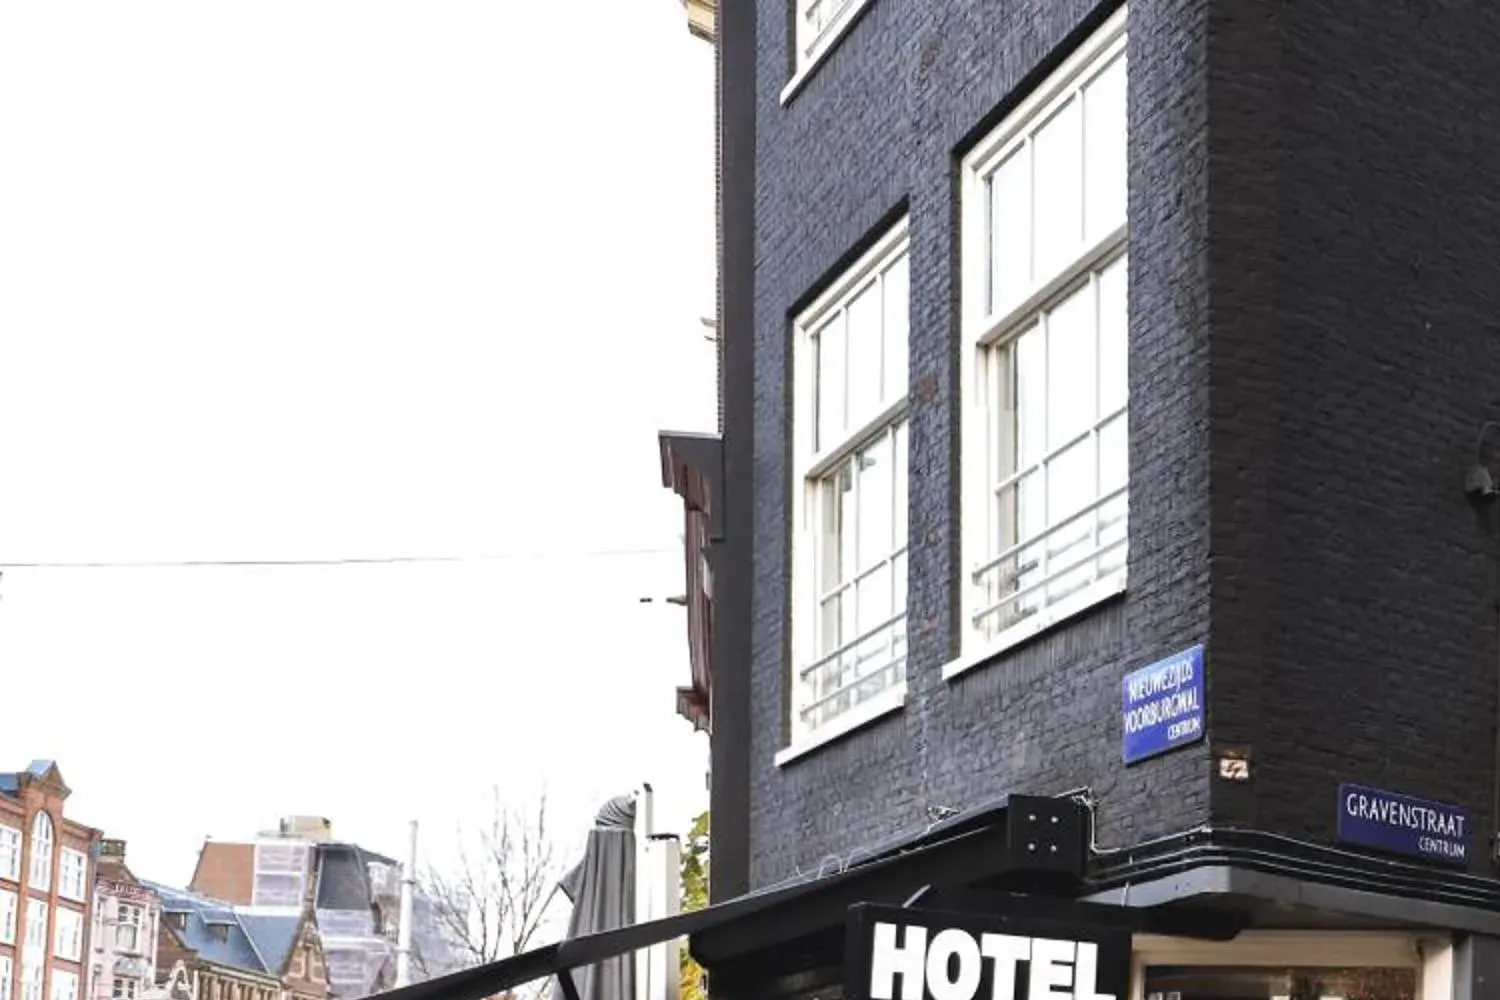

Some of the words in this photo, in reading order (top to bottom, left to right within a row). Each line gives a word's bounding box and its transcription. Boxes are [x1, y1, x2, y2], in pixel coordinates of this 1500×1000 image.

[1124, 687, 1200, 734] VOORBURGWAL
[1167, 717, 1200, 740] CENTRUM
[1347, 793, 1464, 838] GRAVENSTRAAT
[1418, 836, 1465, 858] CENTRUM
